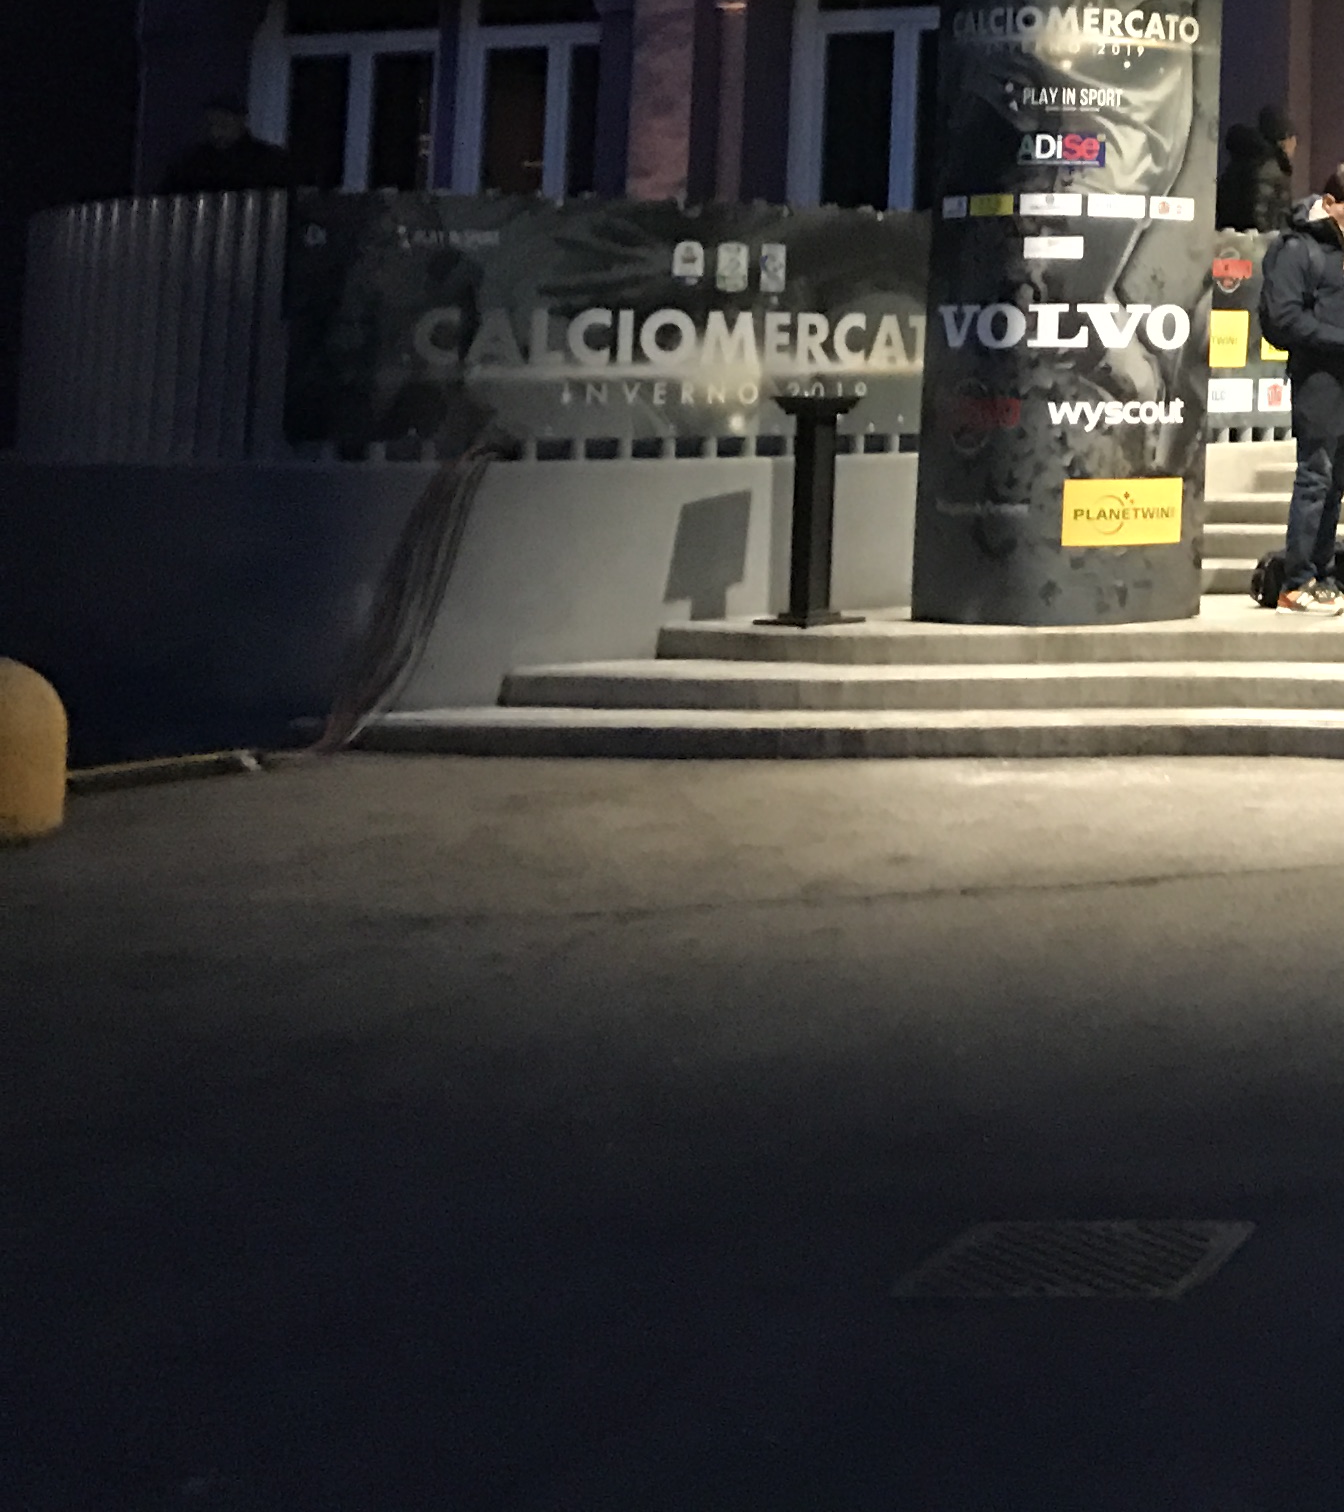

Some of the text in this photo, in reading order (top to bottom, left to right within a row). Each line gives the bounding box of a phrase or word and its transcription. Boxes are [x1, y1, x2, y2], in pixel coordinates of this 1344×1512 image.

[953, 5, 1201, 45] CALCIOMERCATO
[1098, 43, 1145, 57] 2019
[1023, 87, 1123, 107] PLAY IN SPORT
[413, 306, 927, 366] CALCIOMERCAT
[938, 303, 1191, 350] VOLVO
[560, 382, 760, 406] INVERNO
[1048, 397, 1185, 433] wyscout
